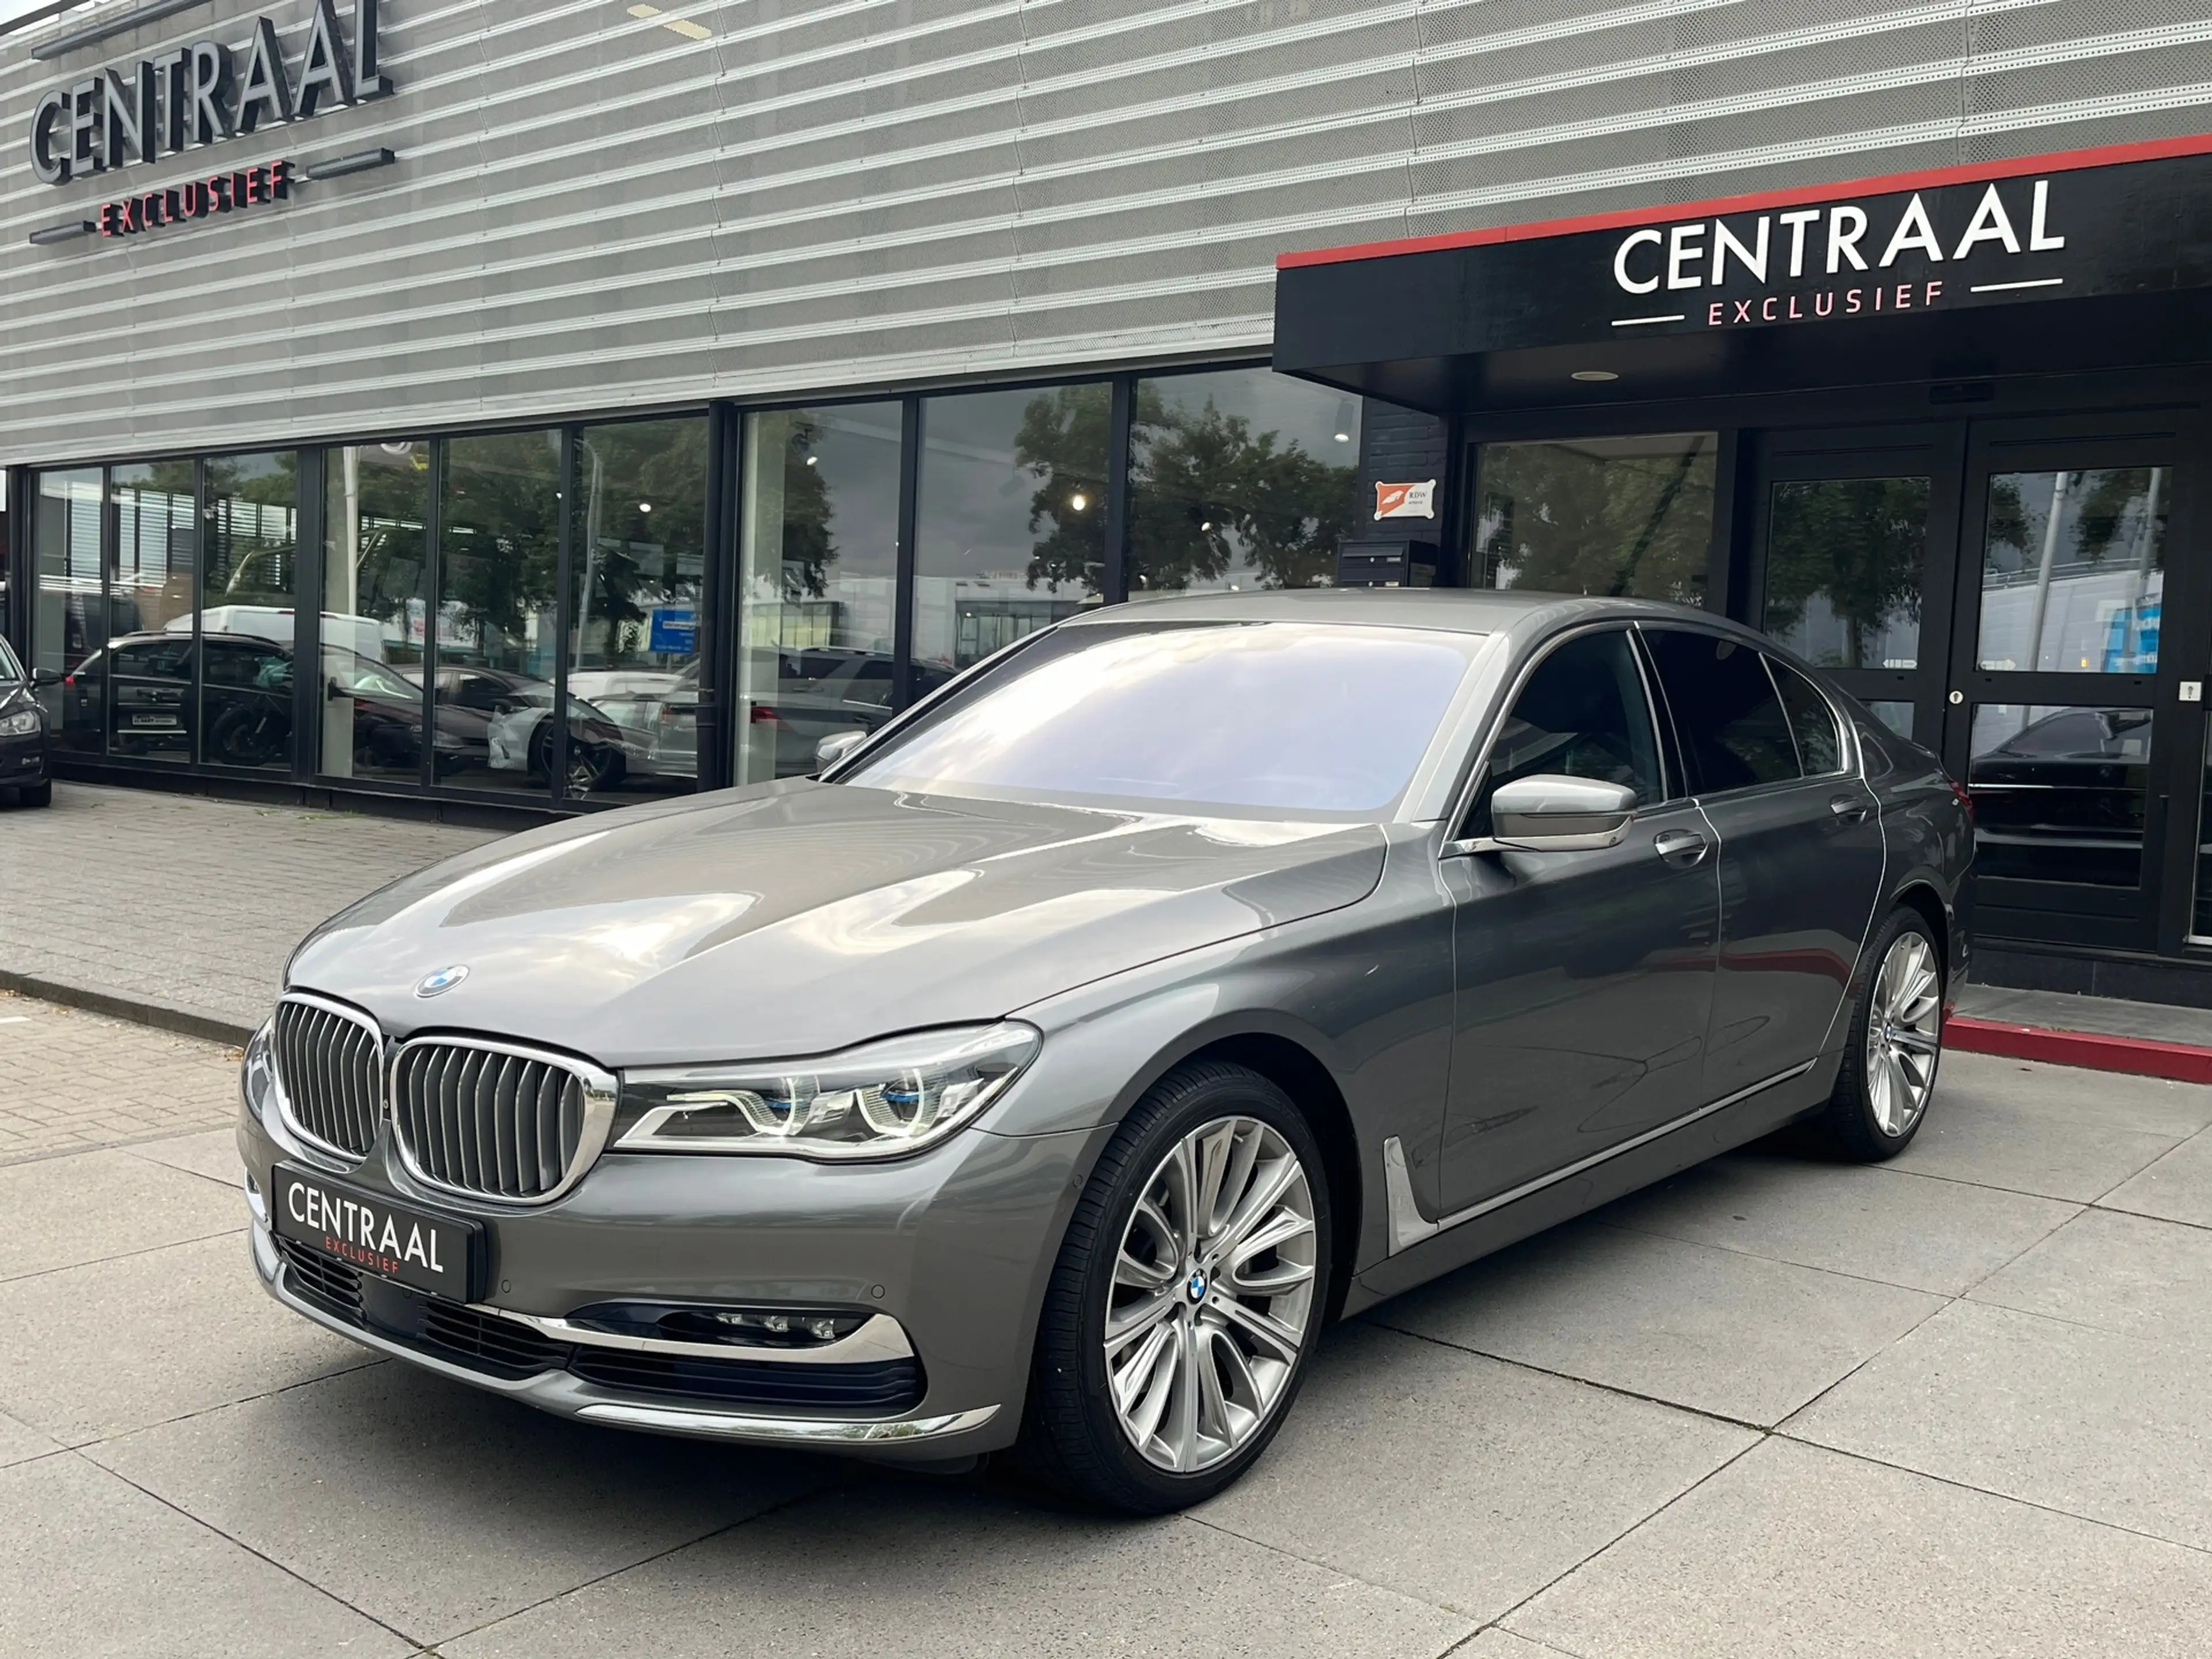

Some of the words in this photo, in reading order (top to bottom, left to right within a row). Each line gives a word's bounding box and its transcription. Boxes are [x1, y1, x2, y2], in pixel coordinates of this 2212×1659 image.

[29, 0, 394, 184] CENTRAAL
[101, 160, 293, 237] EXCLUSIEF
[1613, 180, 2065, 294] CENTRAAL
[1709, 281, 1943, 326] EXCLUSIEF
[288, 1182, 444, 1273] CENTRAAL
[325, 1236, 399, 1274] EXCLUSIEF
